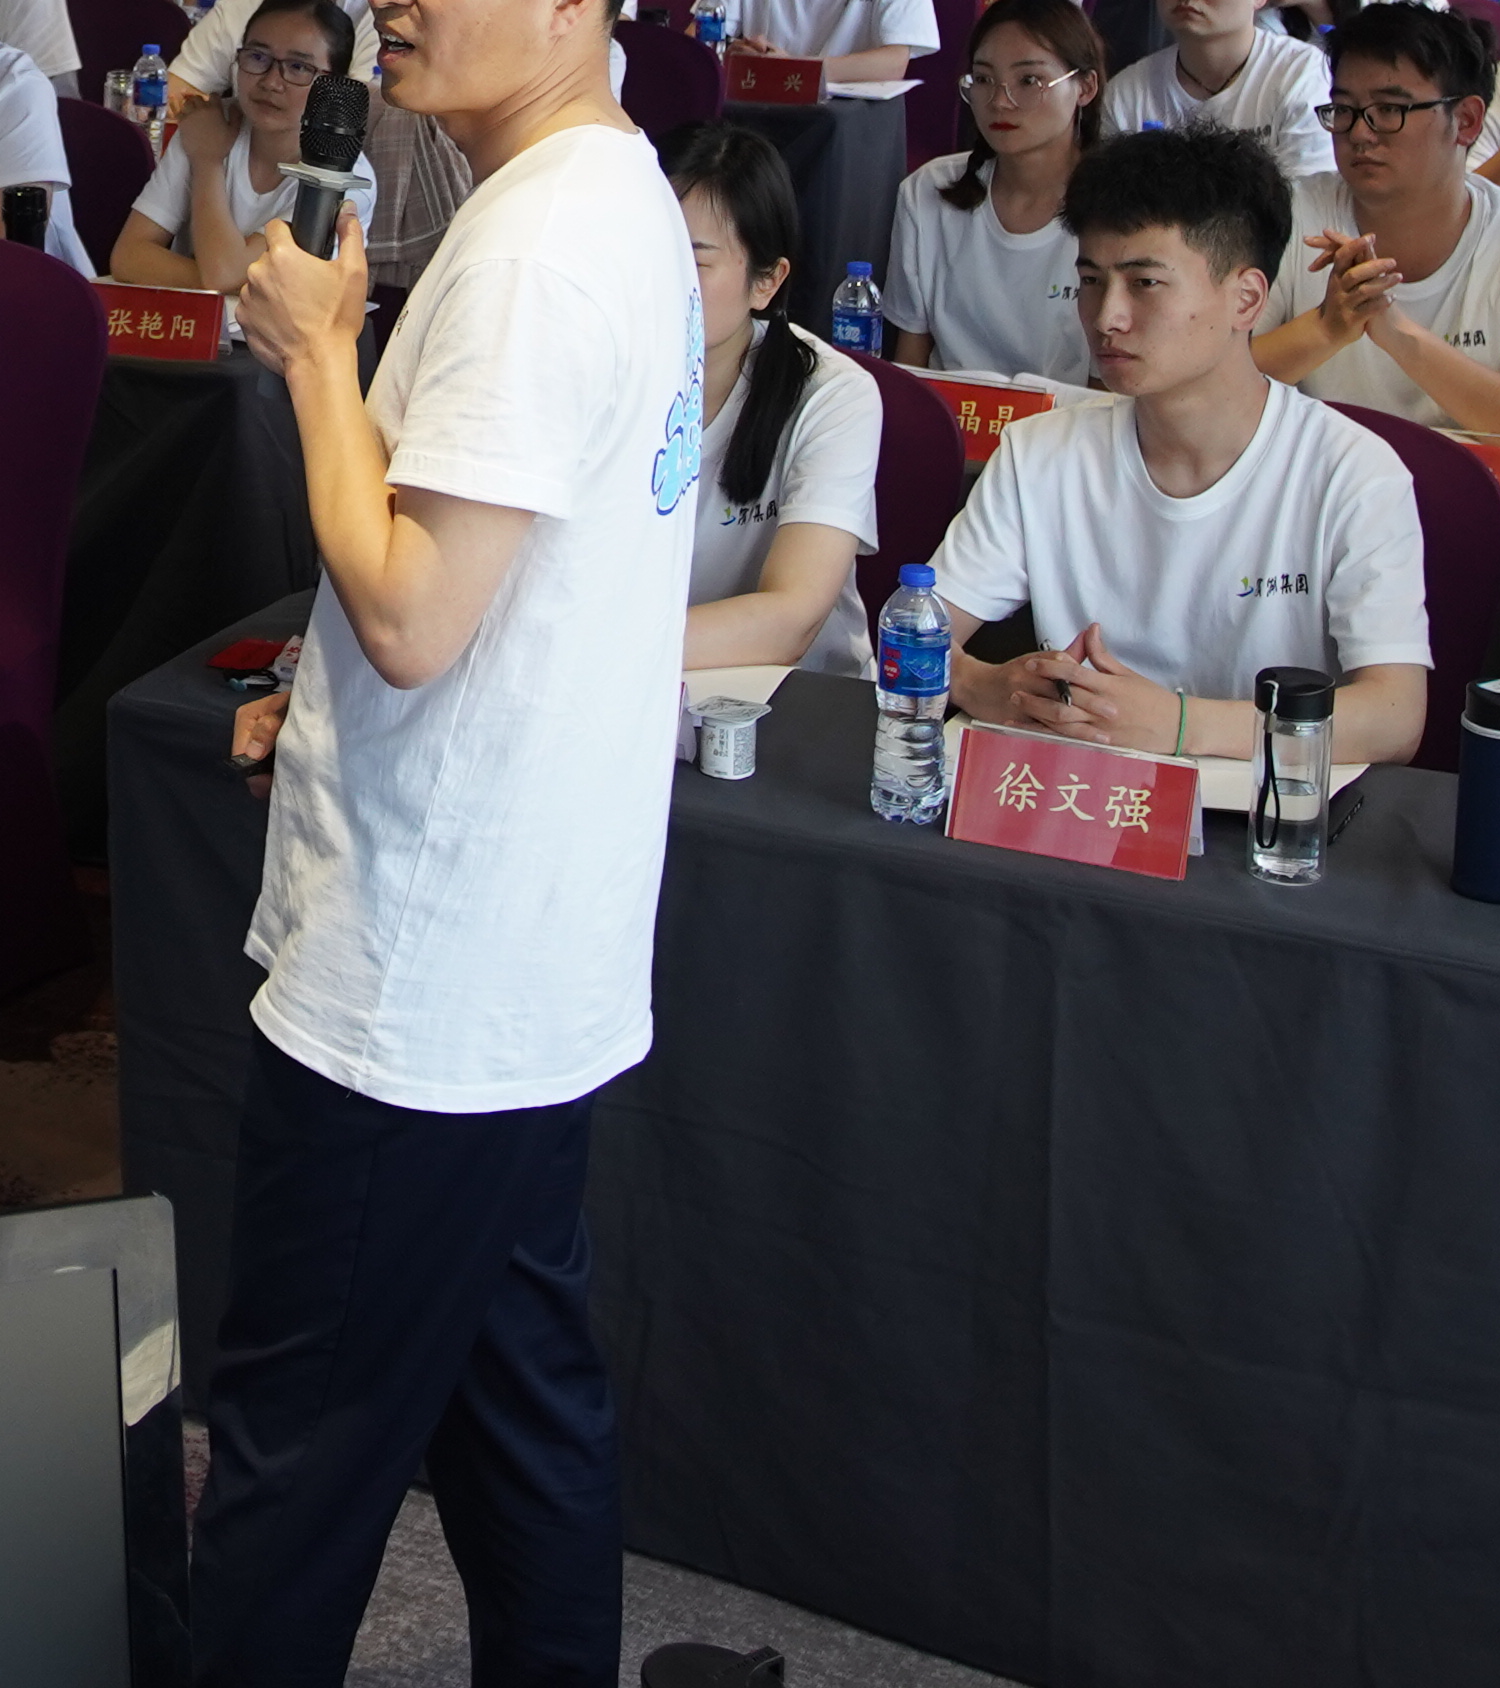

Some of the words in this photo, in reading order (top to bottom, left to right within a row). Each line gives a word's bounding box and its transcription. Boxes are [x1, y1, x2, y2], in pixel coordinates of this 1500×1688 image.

[107, 308, 196, 340] 张艳阳
[993, 761, 1152, 834] 徐文强
